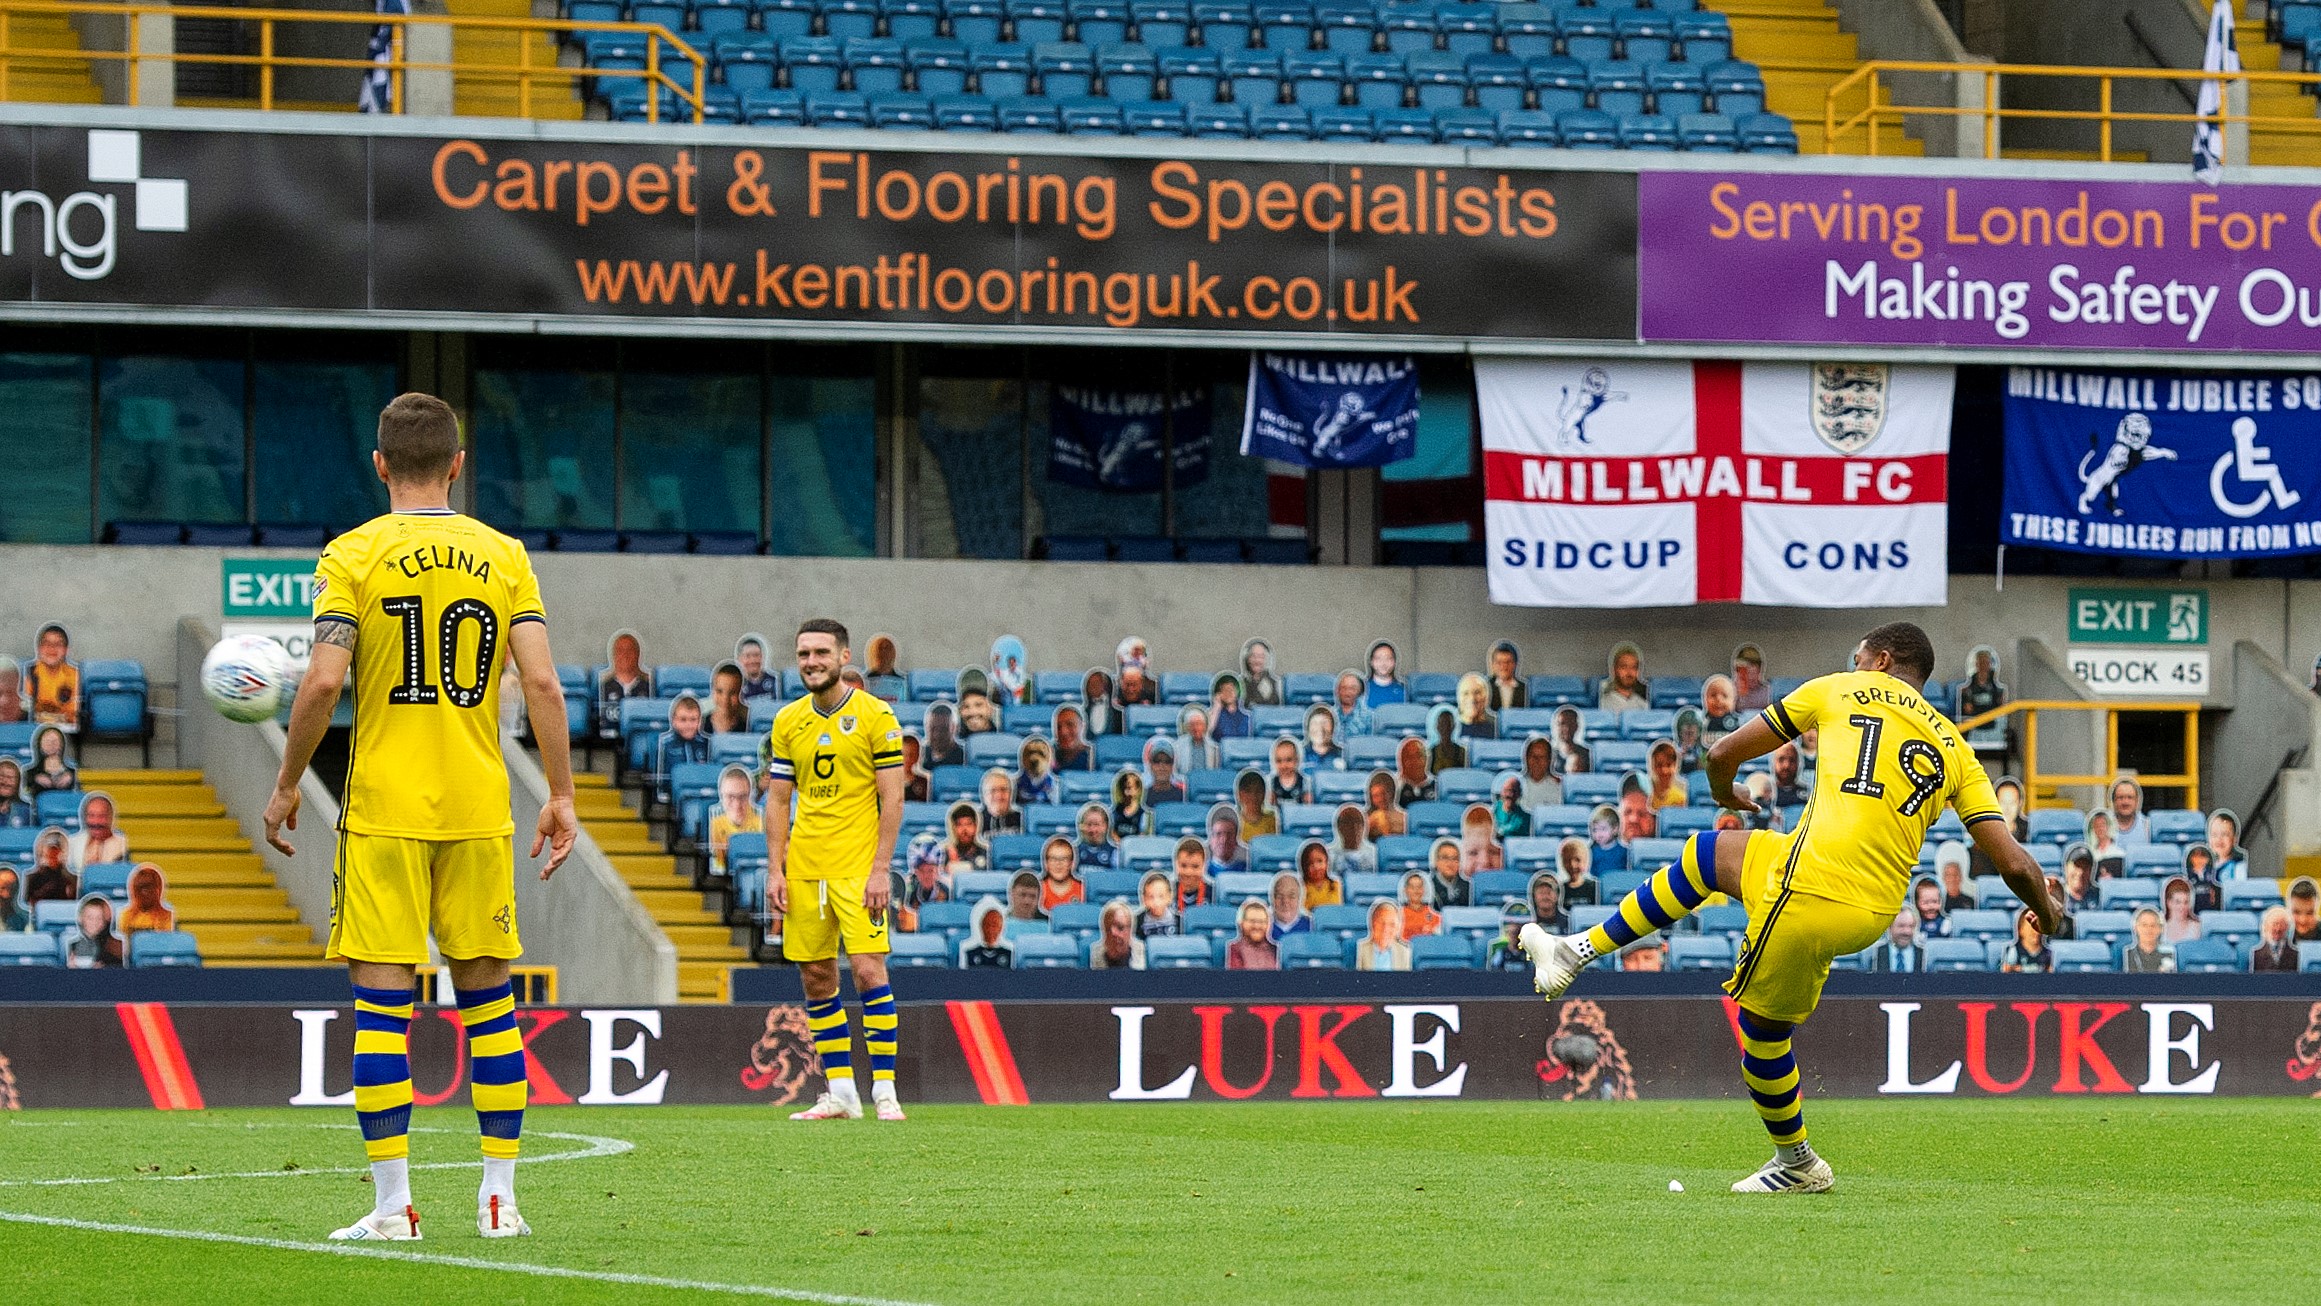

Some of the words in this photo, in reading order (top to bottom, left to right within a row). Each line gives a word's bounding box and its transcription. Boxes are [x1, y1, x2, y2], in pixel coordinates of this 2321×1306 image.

[431, 140, 697, 225] Carpet
[727, 150, 776, 216] &
[808, 152, 1117, 240] Flooring
[1149, 160, 1558, 242] Specialists
[1710, 182, 1923, 260] Serving
[1945, 190, 2164, 250] London
[2190, 194, 2288, 251] For
[1, 189, 117, 280] ng
[576, 248, 1420, 328] www.kentflooringuk.co.uk
[1824, 260, 2031, 340] Making
[2048, 264, 2221, 342] Safety
[2239, 267, 2321, 328] Ou
[2008, 366, 2158, 411] MILLWALL
[2166, 379, 2273, 412] JUBLEE
[1521, 456, 1812, 502] MILLWALL
[1842, 462, 1913, 501] FC
[399, 545, 490, 585] CELINA
[1504, 539, 1681, 570] SIDCUP
[1783, 541, 1909, 571] CONS
[2010, 512, 2079, 545] THESE
[2084, 521, 2176, 552] JUBLEES
[2229, 524, 2290, 552] FROM
[229, 573, 314, 607] EXIT
[2077, 600, 2157, 631] EXIT
[380, 595, 499, 708] 10
[2075, 661, 2158, 684] BLOCK
[2171, 662, 2202, 684] 45
[1853, 687, 1956, 750] BREWSTER
[1840, 713, 1946, 817] 19
[1108, 1003, 1469, 1101] LUKE
[1877, 1001, 2222, 1094] LUKE
